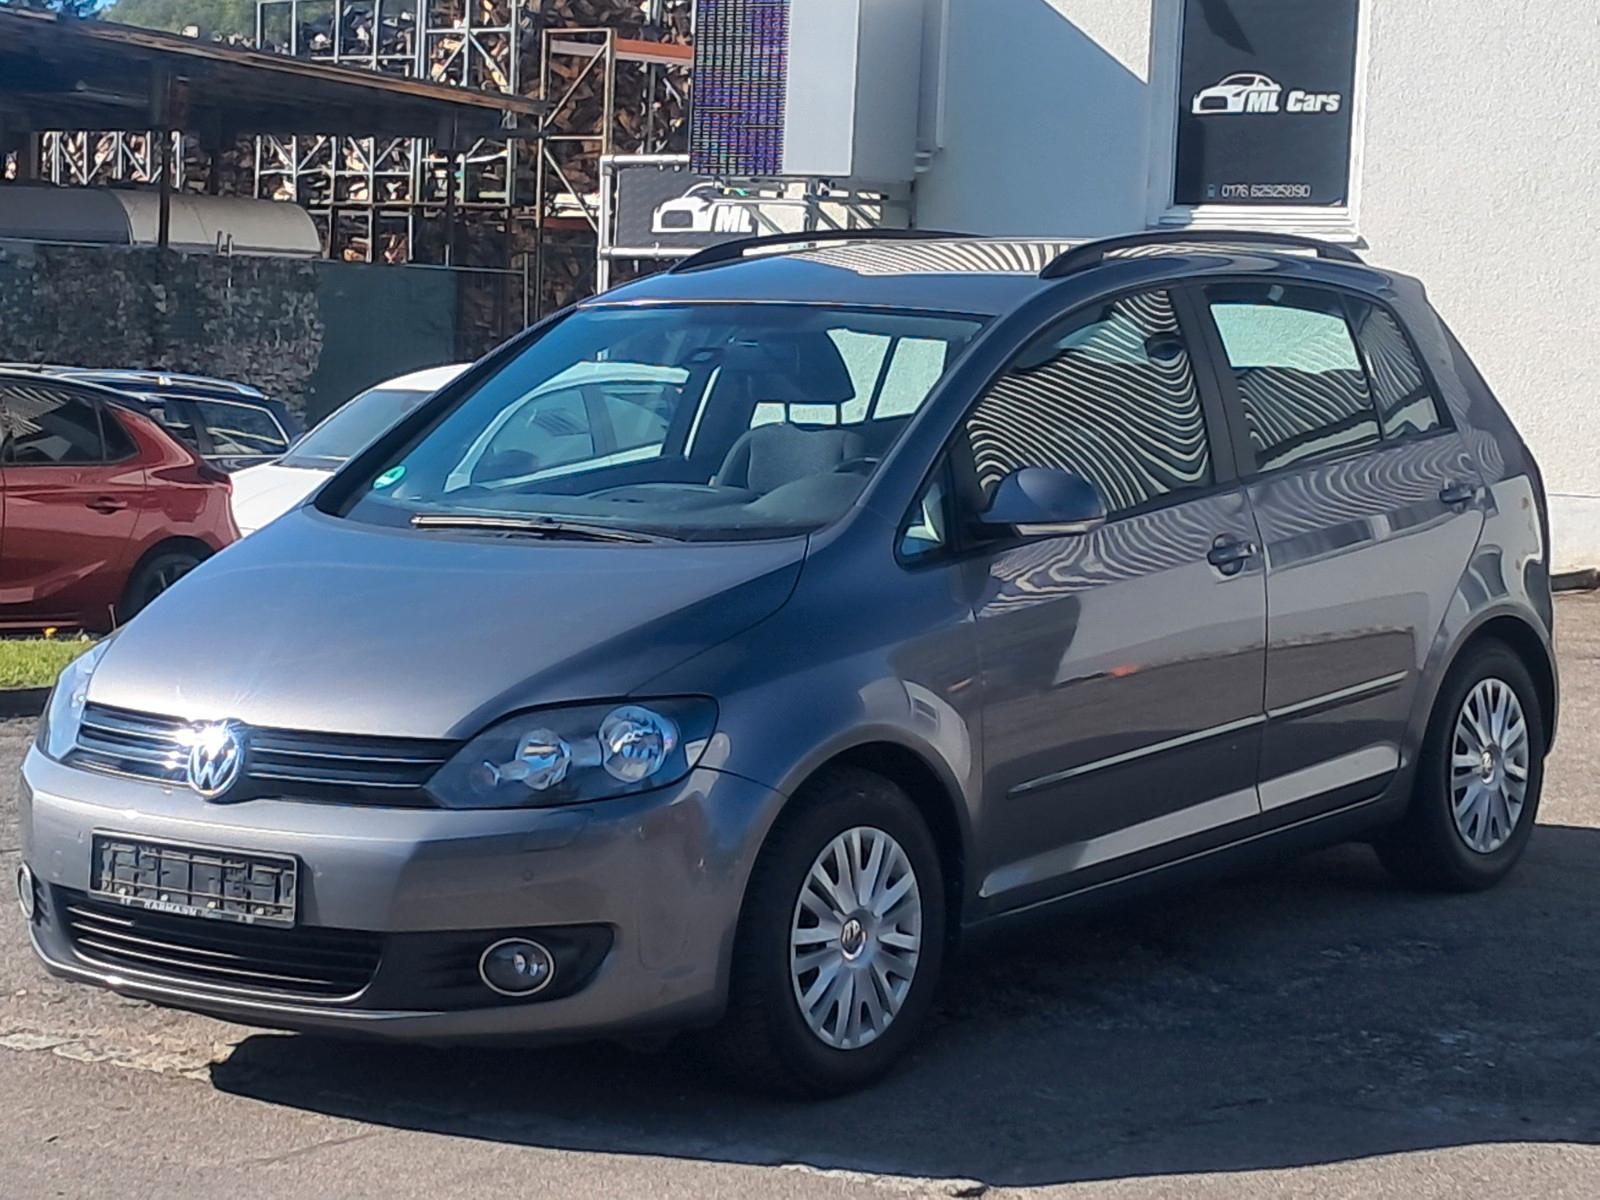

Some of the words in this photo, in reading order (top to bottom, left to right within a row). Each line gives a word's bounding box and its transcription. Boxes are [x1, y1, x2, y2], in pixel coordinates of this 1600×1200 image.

[1246, 91, 1280, 112] ML
[1286, 90, 1341, 112] Cars
[714, 205, 753, 233] ML
